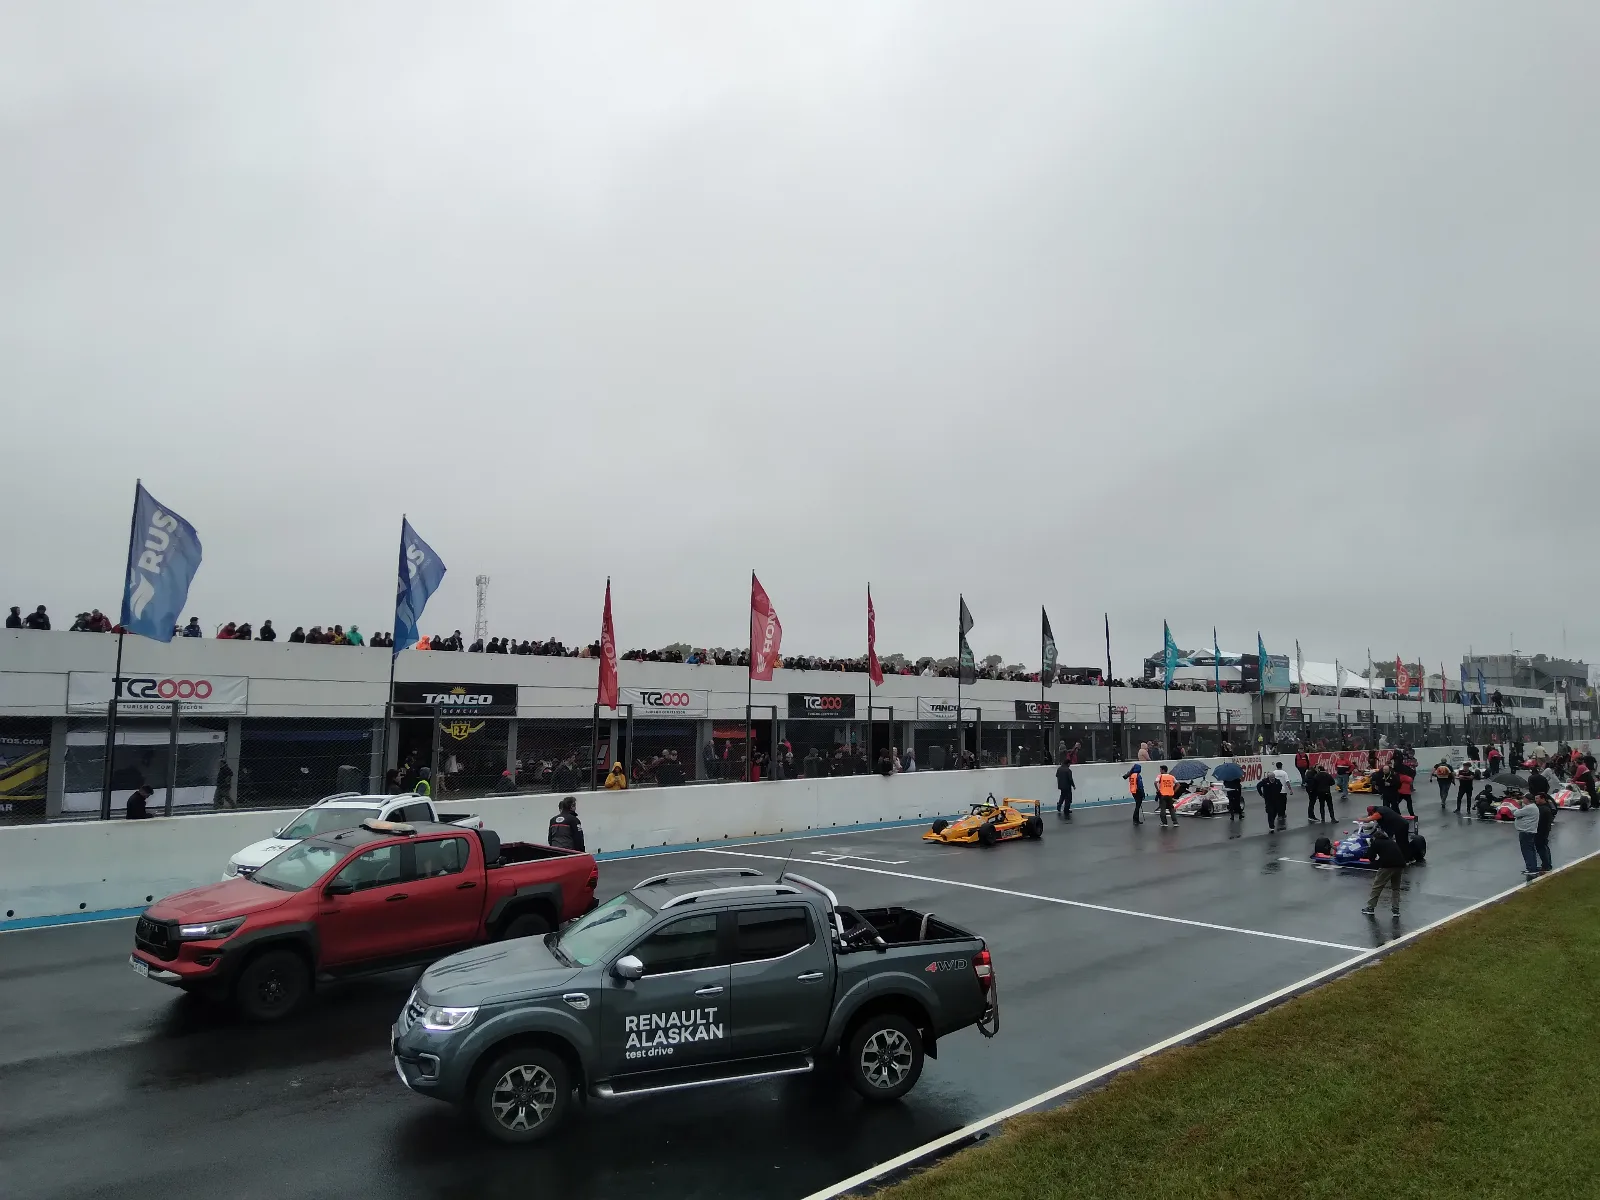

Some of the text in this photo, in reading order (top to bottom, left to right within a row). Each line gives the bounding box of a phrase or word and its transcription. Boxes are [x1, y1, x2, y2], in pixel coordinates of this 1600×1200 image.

[138, 509, 178, 574] RUS
[112, 677, 213, 699] TC2000
[422, 693, 493, 705] TANGO
[640, 692, 690, 707] TC2000
[803, 695, 842, 709] TC2000
[925, 958, 968, 972] 4WD
[625, 1007, 718, 1032] RENAULT
[625, 1023, 724, 1049] ALASKAN
[625, 1047, 674, 1060] test drive
